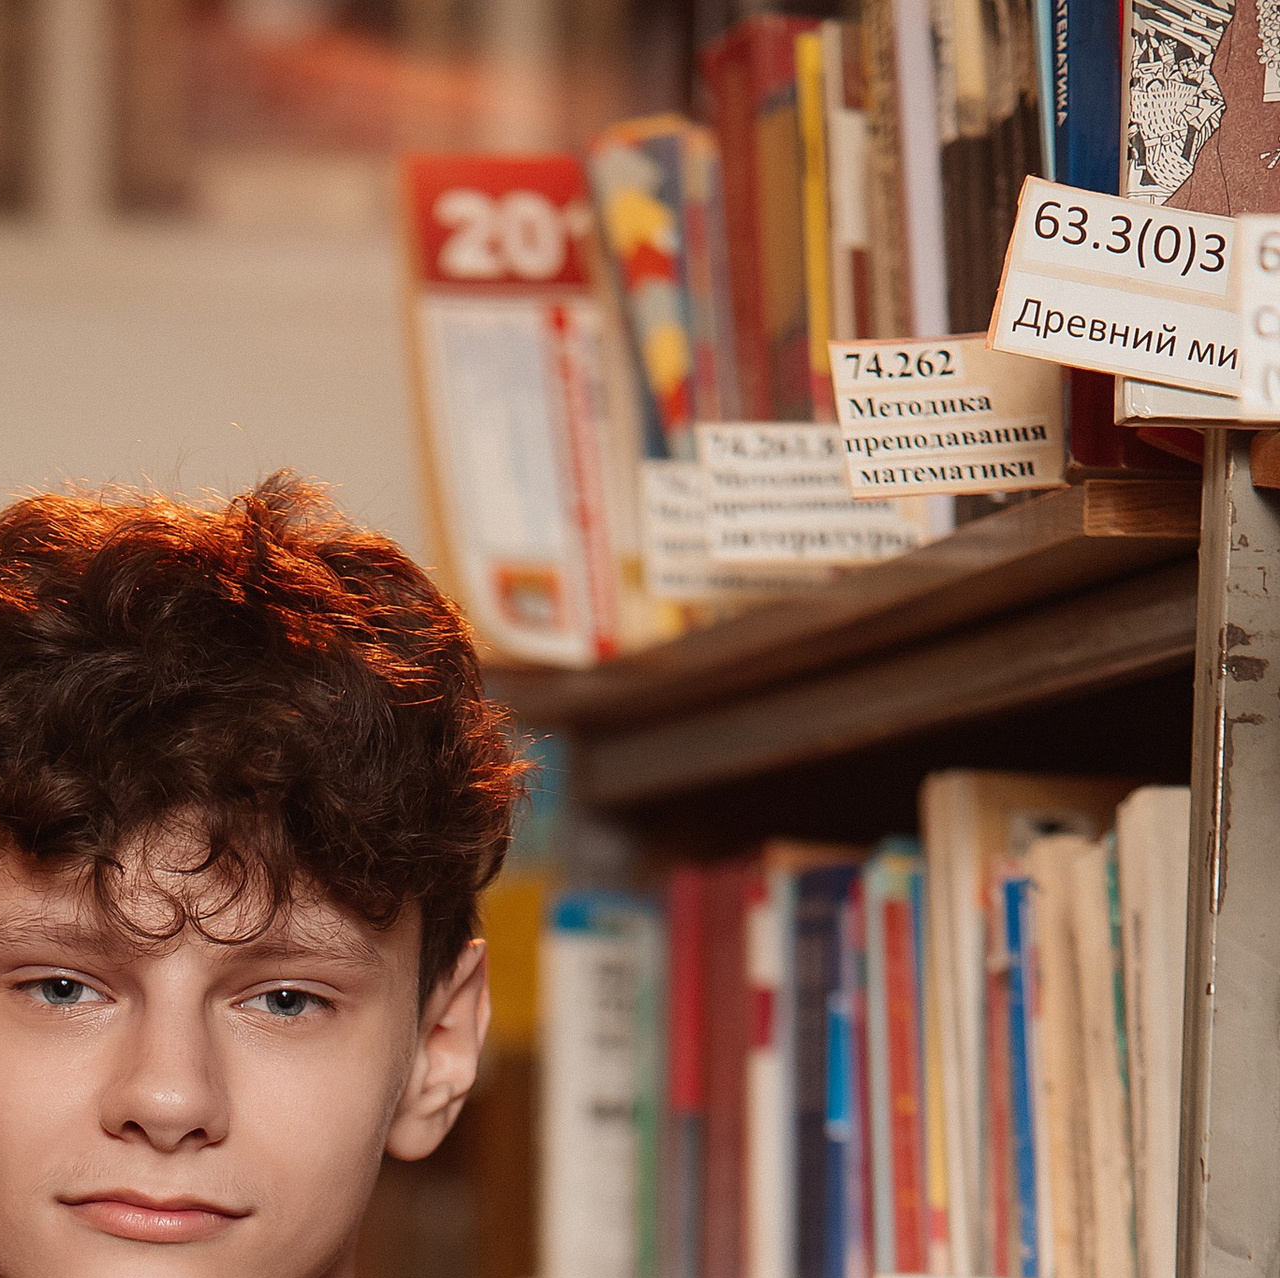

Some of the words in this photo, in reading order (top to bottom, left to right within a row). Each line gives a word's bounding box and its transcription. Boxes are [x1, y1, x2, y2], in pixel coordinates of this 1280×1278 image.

[1034, 200, 1227, 277] 63.3(0)3
[1012, 297, 1178, 358] Древний
[1187, 339, 1239, 371] ми
[845, 349, 955, 380] 74.262
[849, 394, 993, 419] Методика
[845, 424, 1048, 457] преподавания
[861, 460, 1036, 486] математики
